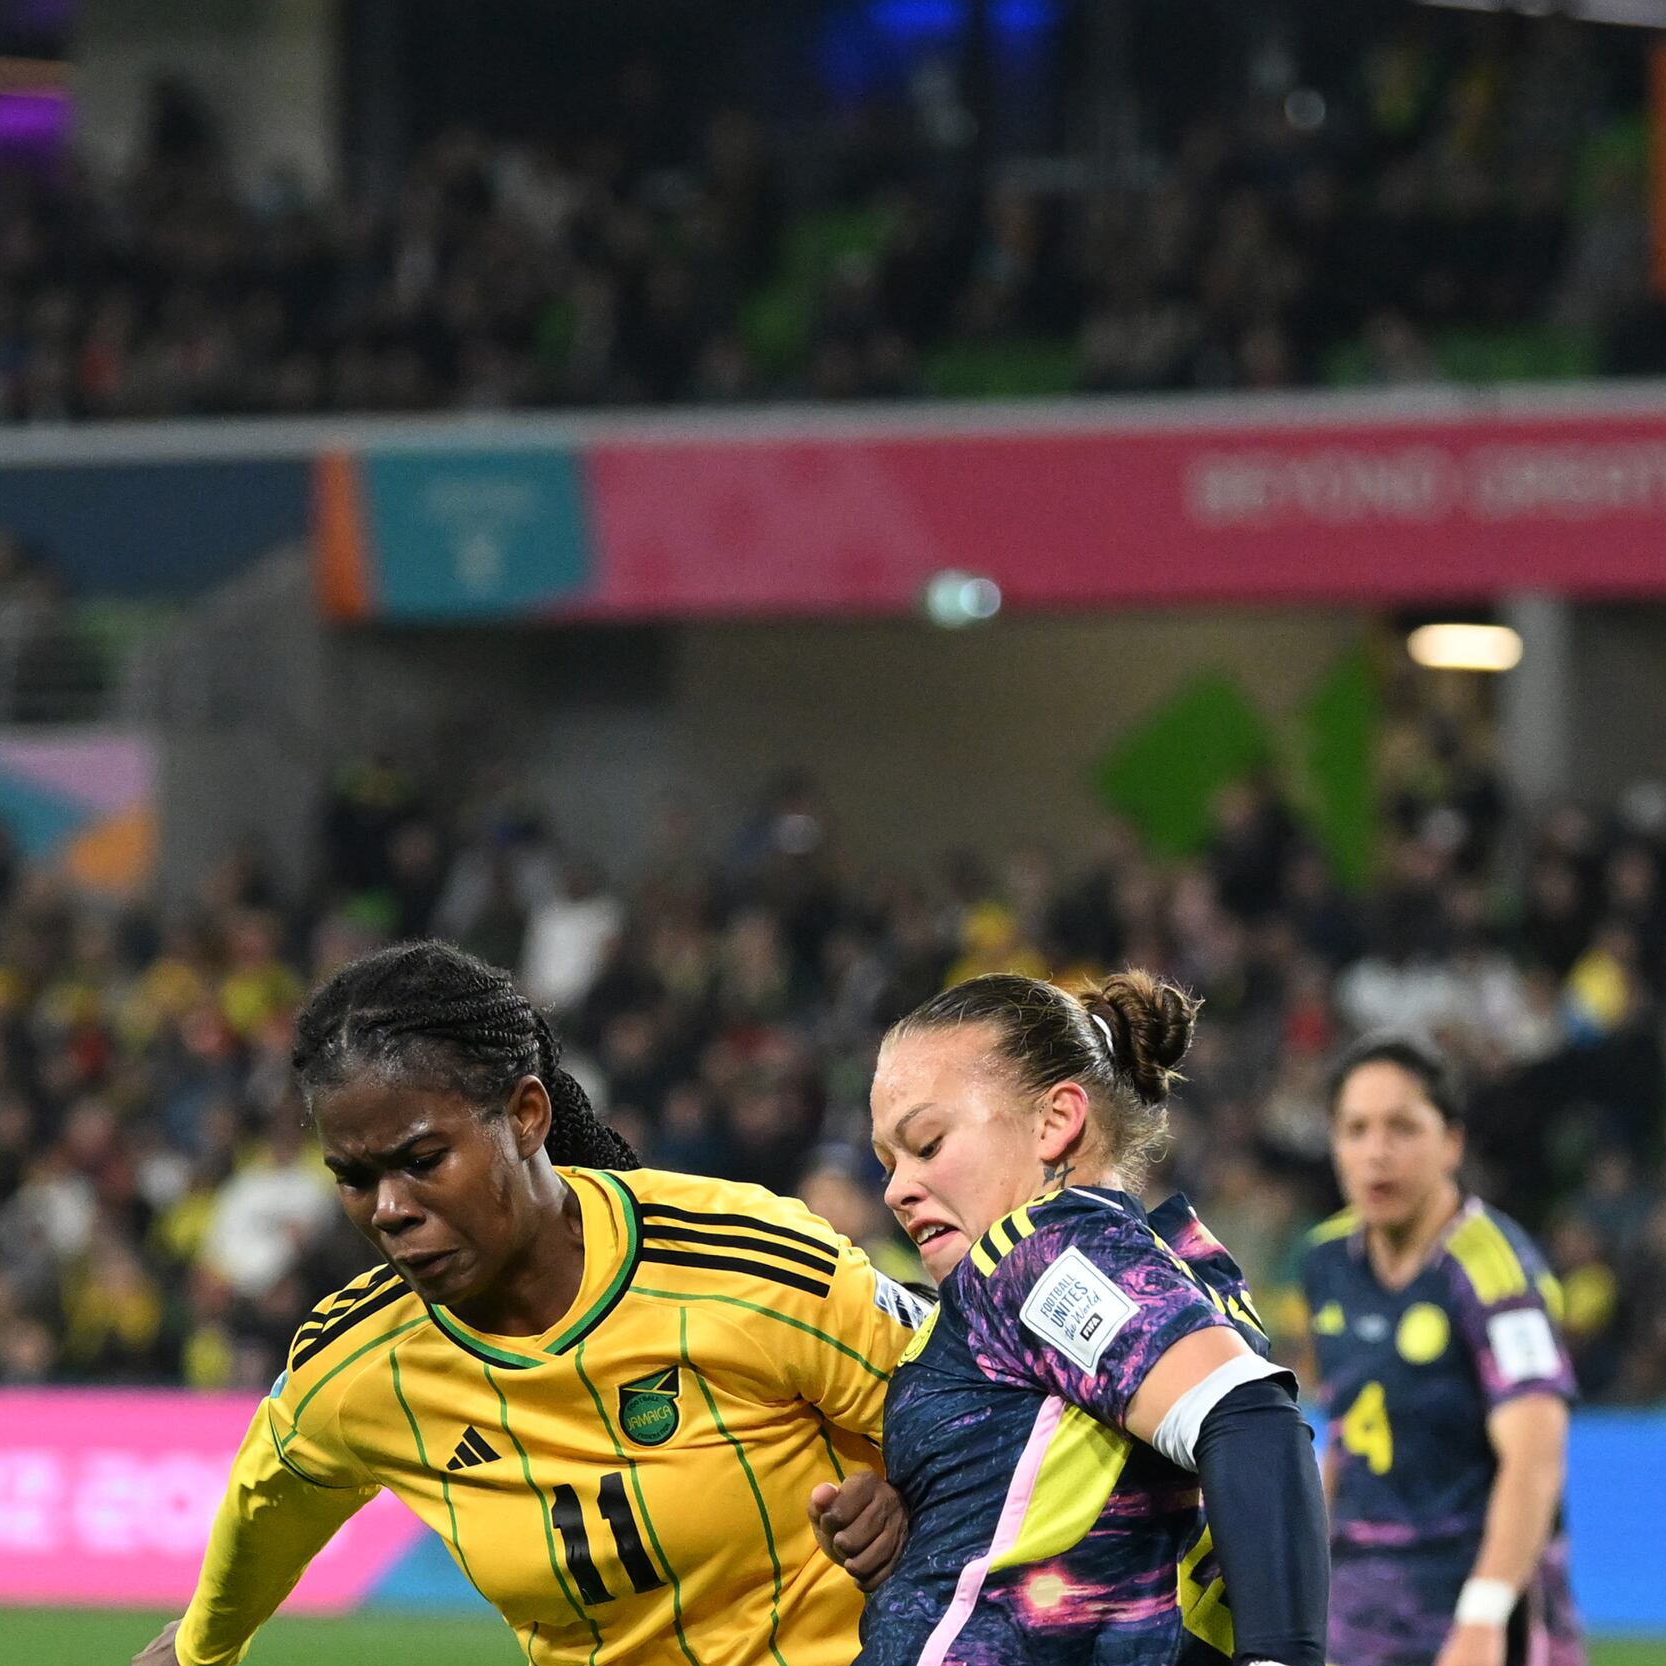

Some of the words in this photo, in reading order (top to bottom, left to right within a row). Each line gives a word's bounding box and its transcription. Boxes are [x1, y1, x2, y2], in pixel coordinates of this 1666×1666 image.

[1189, 448, 1450, 528] BEYOND
[1040, 1274, 1076, 1317] FOOTBALL
[1050, 1281, 1088, 1328] UNITES
[1063, 1323, 1077, 1341] the
[1071, 1290, 1101, 1324] World
[1081, 1313, 1103, 1341] FIFA
[627, 1405, 672, 1431] JAMAICA
[1342, 1380, 1394, 1476] 4
[552, 1473, 667, 1605] 11
